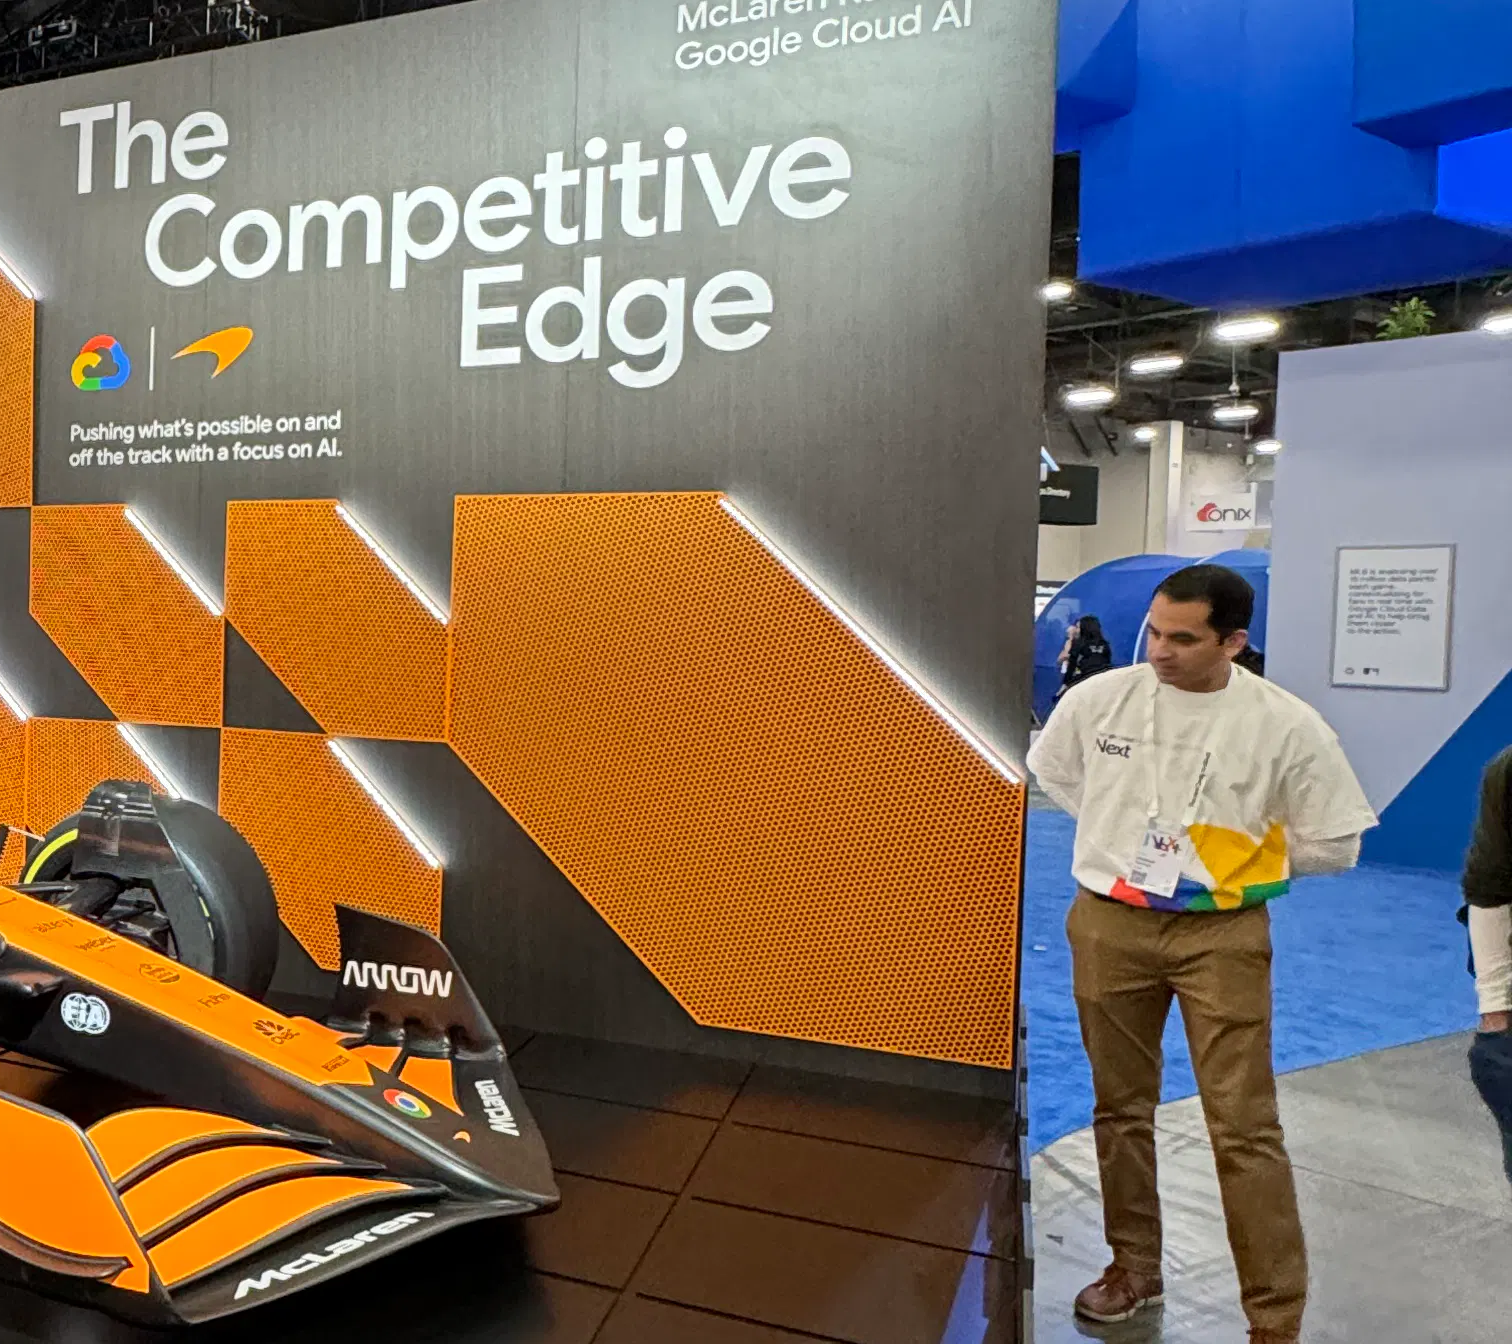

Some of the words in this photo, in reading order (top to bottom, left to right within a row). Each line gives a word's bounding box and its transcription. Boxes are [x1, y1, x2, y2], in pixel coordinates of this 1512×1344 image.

[675, 28, 802, 70] Google
[813, 4, 921, 48] Cloud
[60, 101, 229, 194] The
[145, 126, 852, 289] Competitive
[461, 256, 773, 388] Edge
[69, 448, 93, 467] off
[96, 448, 124, 466] the
[127, 445, 173, 465] track
[175, 443, 214, 463] with
[217, 446, 229, 462] a
[232, 441, 284, 461] focus
[287, 442, 312, 459] on
[316, 437, 343, 457] AI.
[70, 422, 135, 444] Pushing
[138, 418, 194, 439] what's
[197, 414, 272, 440] possible
[276, 415, 300, 433] on
[304, 409, 342, 431] and
[1095, 738, 1131, 759] Next
[234, 1211, 435, 1300] McLaren
